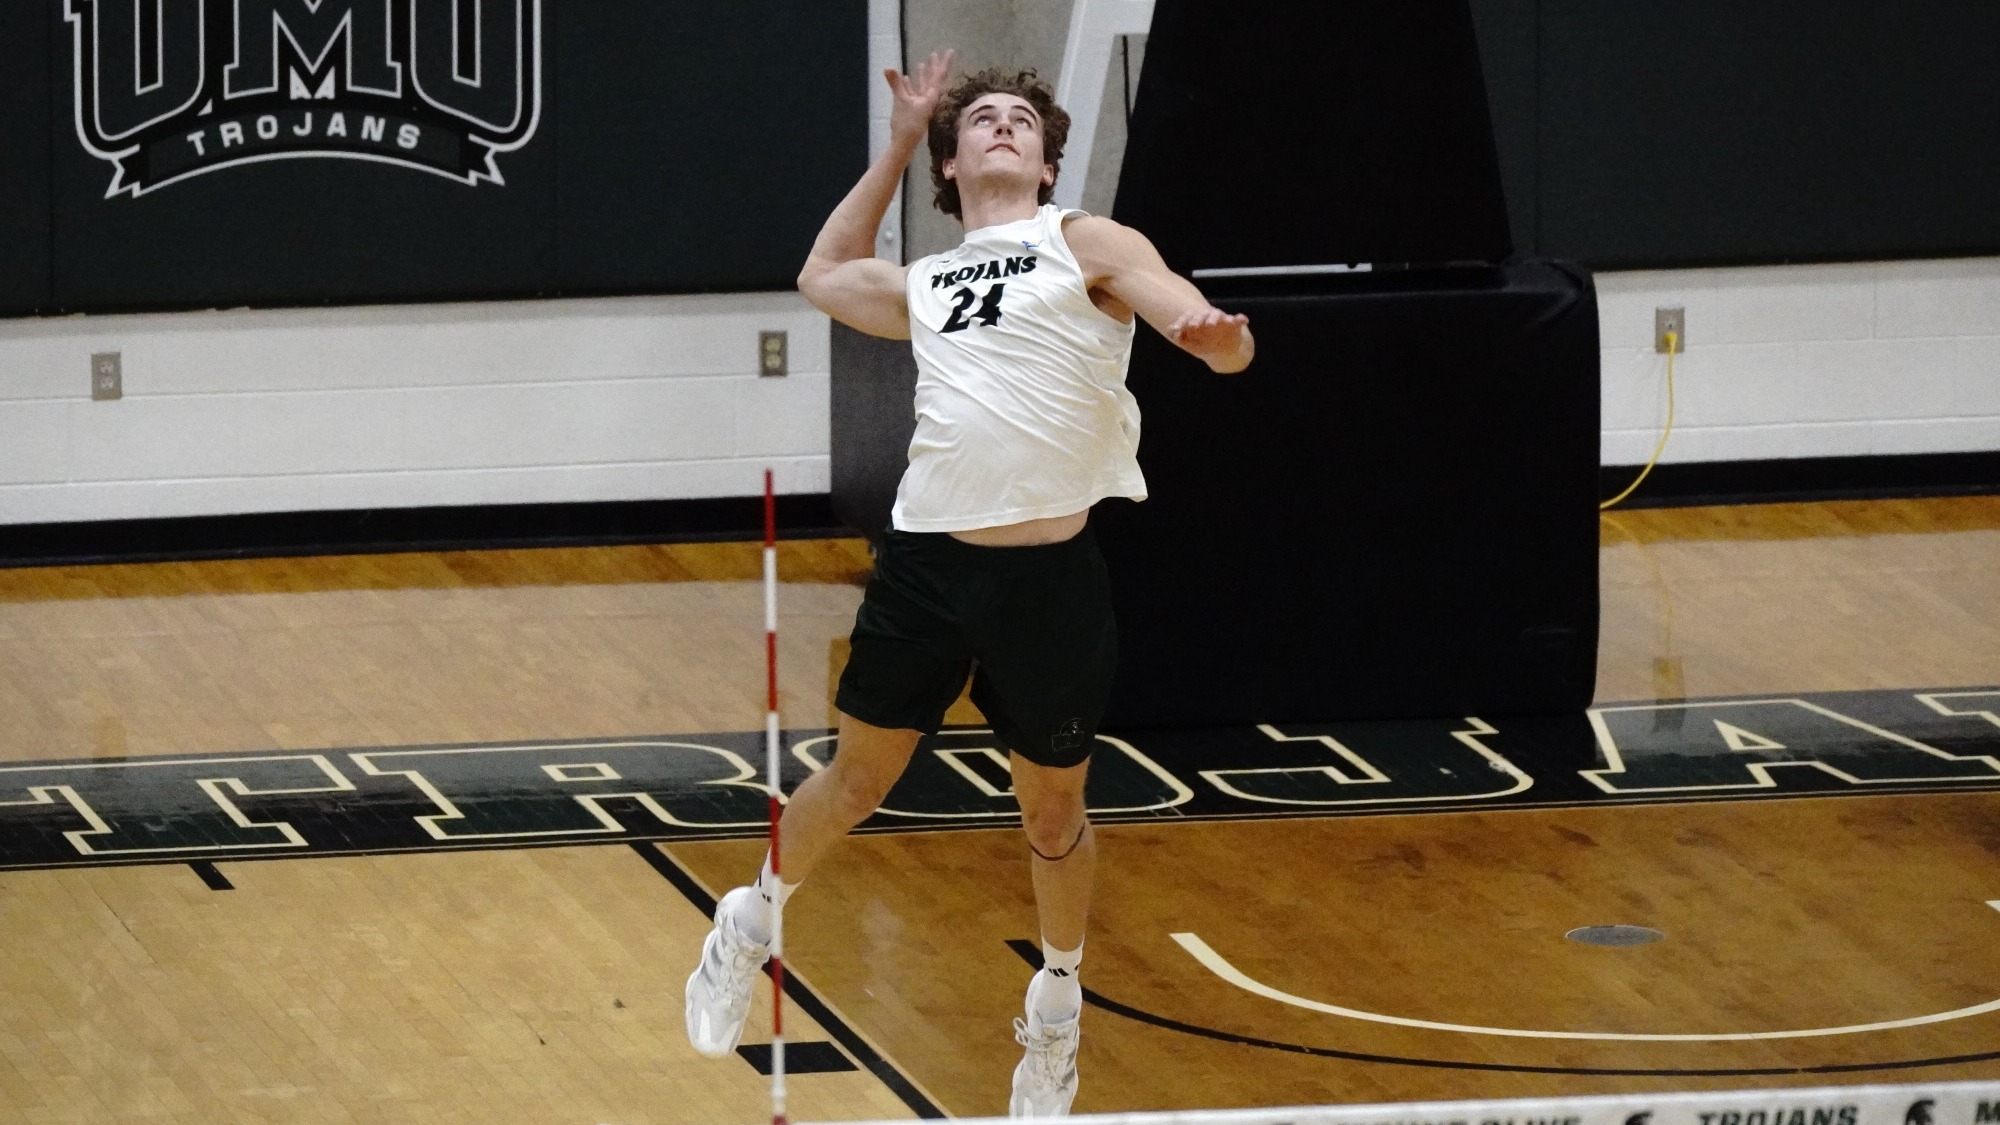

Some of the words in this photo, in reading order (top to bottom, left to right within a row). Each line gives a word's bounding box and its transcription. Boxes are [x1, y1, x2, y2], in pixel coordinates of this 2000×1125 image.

[186, 111, 421, 156] TROJANS
[931, 256, 1037, 291] TROJANS
[938, 283, 1007, 334] 24
[0, 691, 2000, 856] TROJA
